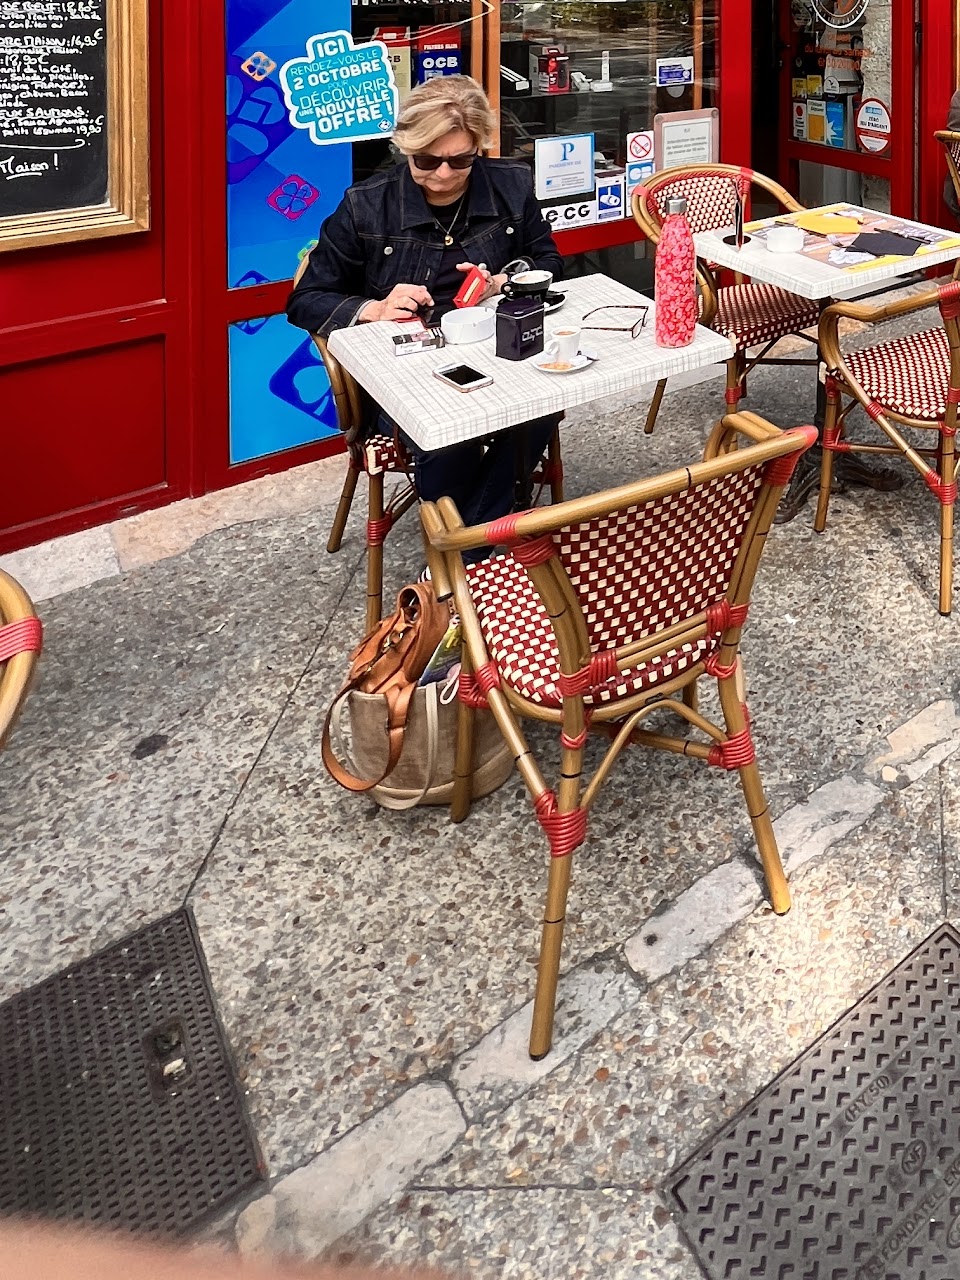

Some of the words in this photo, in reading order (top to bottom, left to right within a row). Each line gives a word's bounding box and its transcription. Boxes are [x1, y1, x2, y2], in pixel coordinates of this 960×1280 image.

[316, 39, 345, 58] ICI
[291, 54, 365, 76] RENDEZ-VOUS
[366, 49, 378, 60] LE
[293, 77, 304, 90] 2
[307, 59, 381, 87] OCTOBRE
[423, 57, 457, 68] OCB
[300, 77, 388, 109] DÉCOUVRIR
[327, 80, 348, 90] POUR
[299, 108, 314, 116] UNE
[315, 90, 390, 118] NOUVELLE
[318, 103, 382, 133] OFFRE
[560, 142, 575, 161] P
[882, 1188, 945, 1261] FONDATEL
